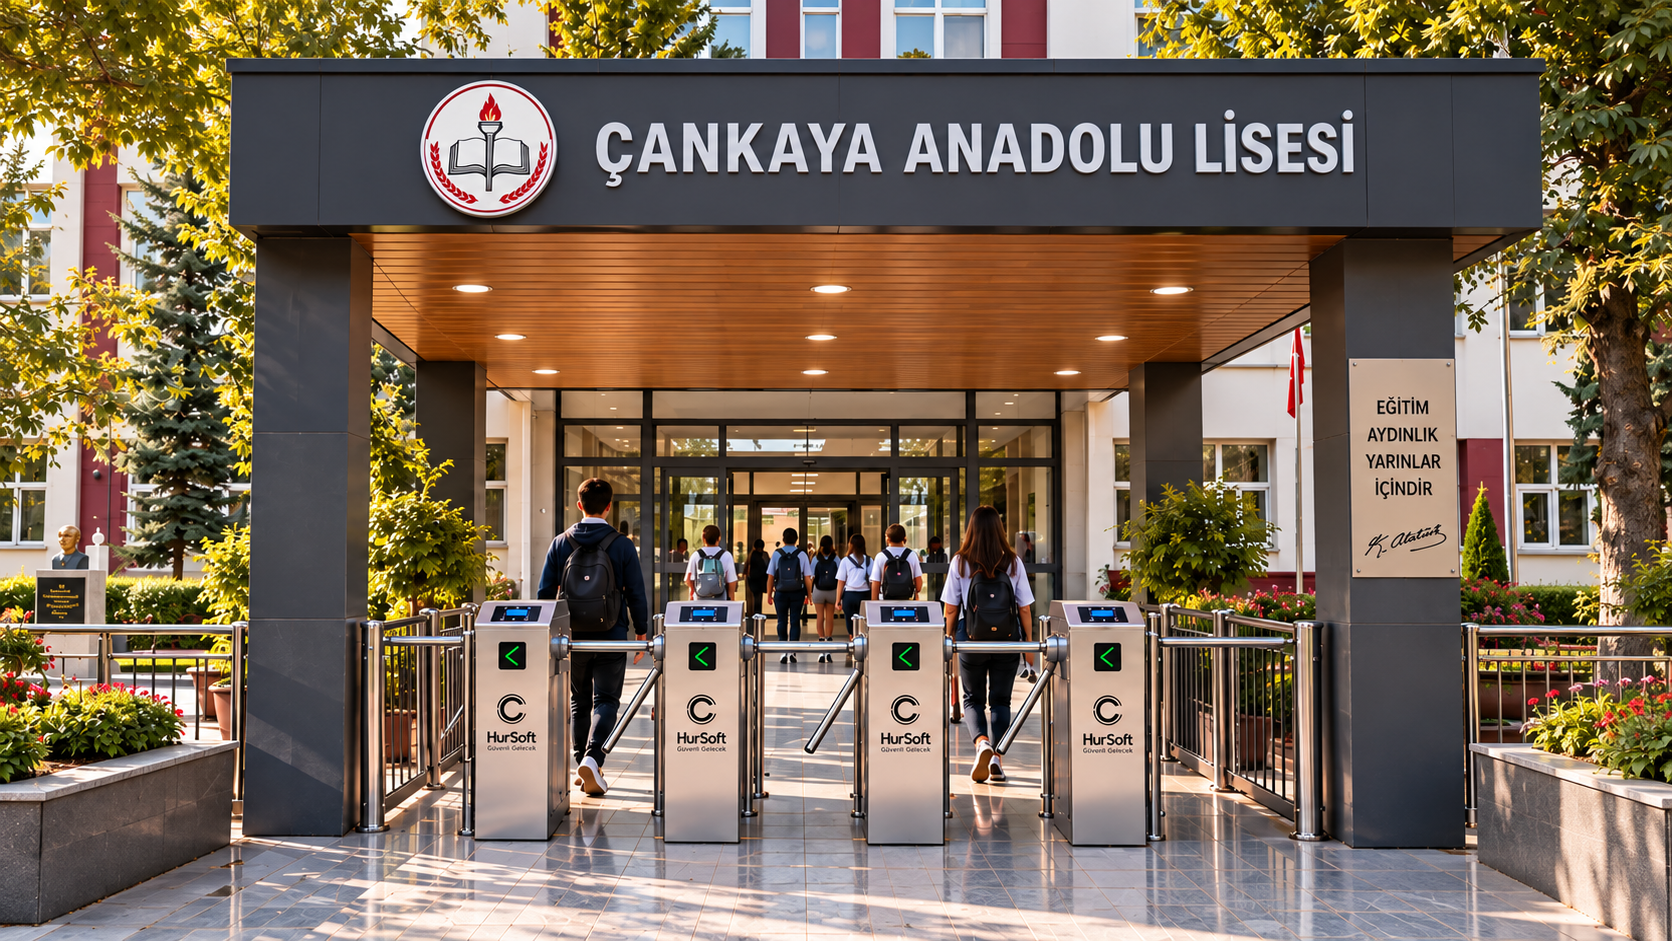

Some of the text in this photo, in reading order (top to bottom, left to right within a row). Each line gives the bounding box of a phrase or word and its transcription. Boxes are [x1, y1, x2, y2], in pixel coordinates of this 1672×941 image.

[595, 109, 1355, 187] ÇANKAYA ANADOLU LİSESİ
[1376, 396, 1430, 415] EĞİTİM
[1367, 426, 1439, 443] AYDINLIK
[1365, 453, 1442, 470] YARINLAR
[1374, 477, 1433, 500] İÇİNDİR
[487, 731, 537, 744] HurSoft
[677, 731, 727, 744] HurSoft
[880, 732, 932, 745] HurSoft
[1083, 732, 1134, 746] HurSoft
